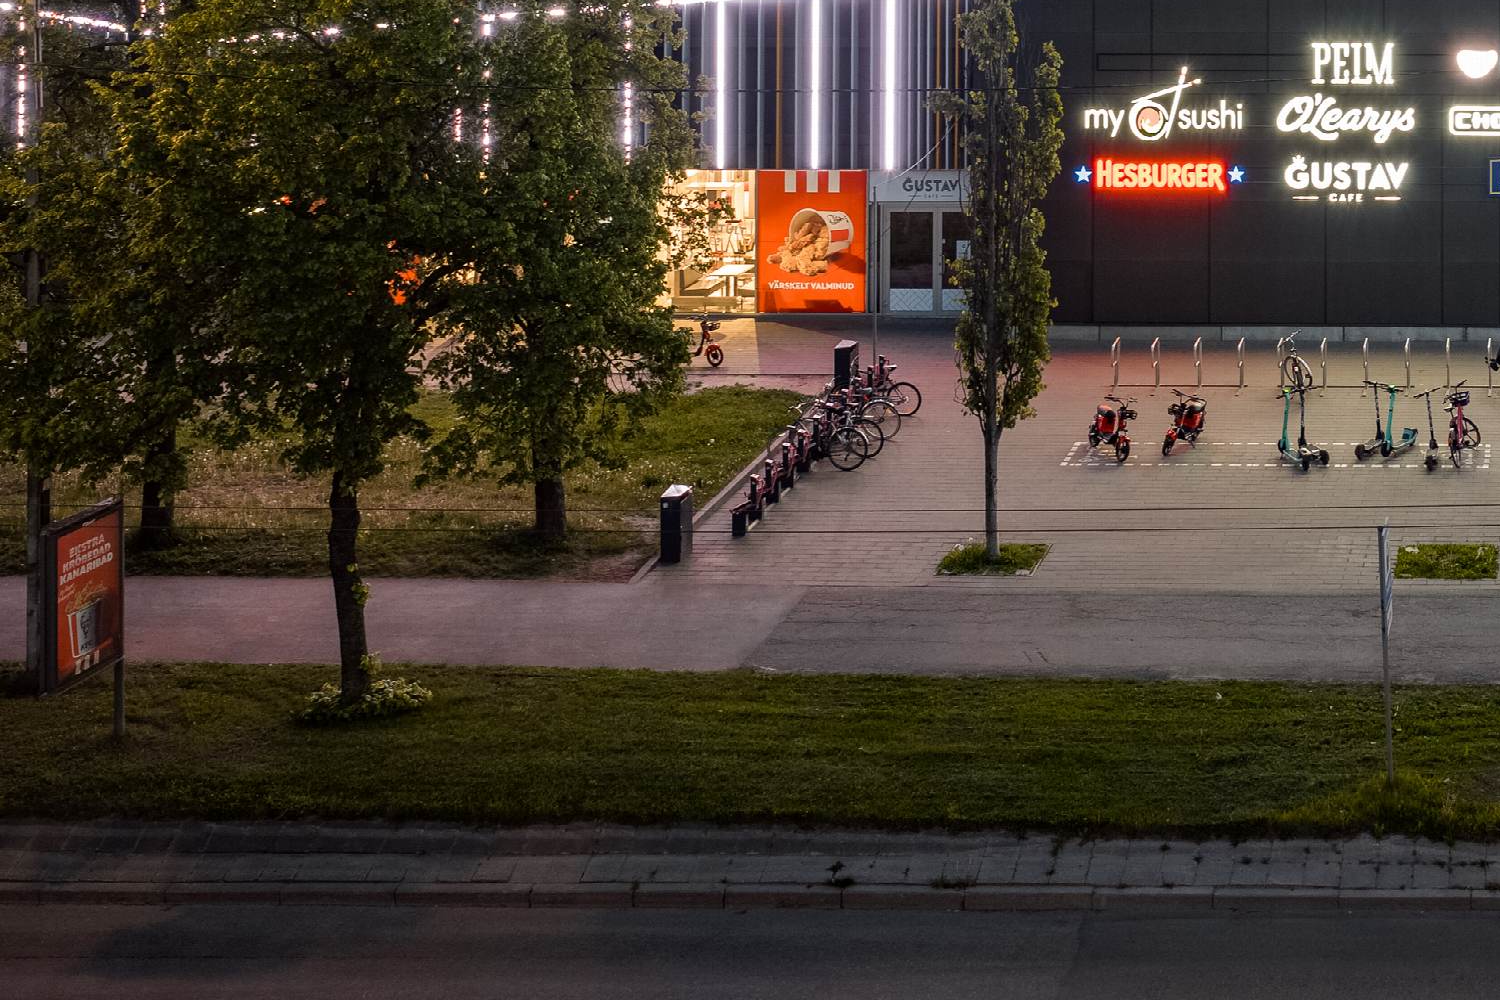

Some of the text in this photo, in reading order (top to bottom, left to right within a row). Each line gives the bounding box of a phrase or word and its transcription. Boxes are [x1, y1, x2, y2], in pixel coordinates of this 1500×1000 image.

[1311, 42, 1395, 85] PELM
[1083, 99, 1243, 138] my sushi
[1276, 92, 1416, 144] O'Learys
[902, 178, 960, 192] GUSTAV
[1096, 159, 1226, 191] HESBURGER
[1284, 156, 1409, 190] GUSTAV
[1328, 193, 1364, 202] CAFE
[767, 279, 855, 290] VÄRSKELT VALMINUD
